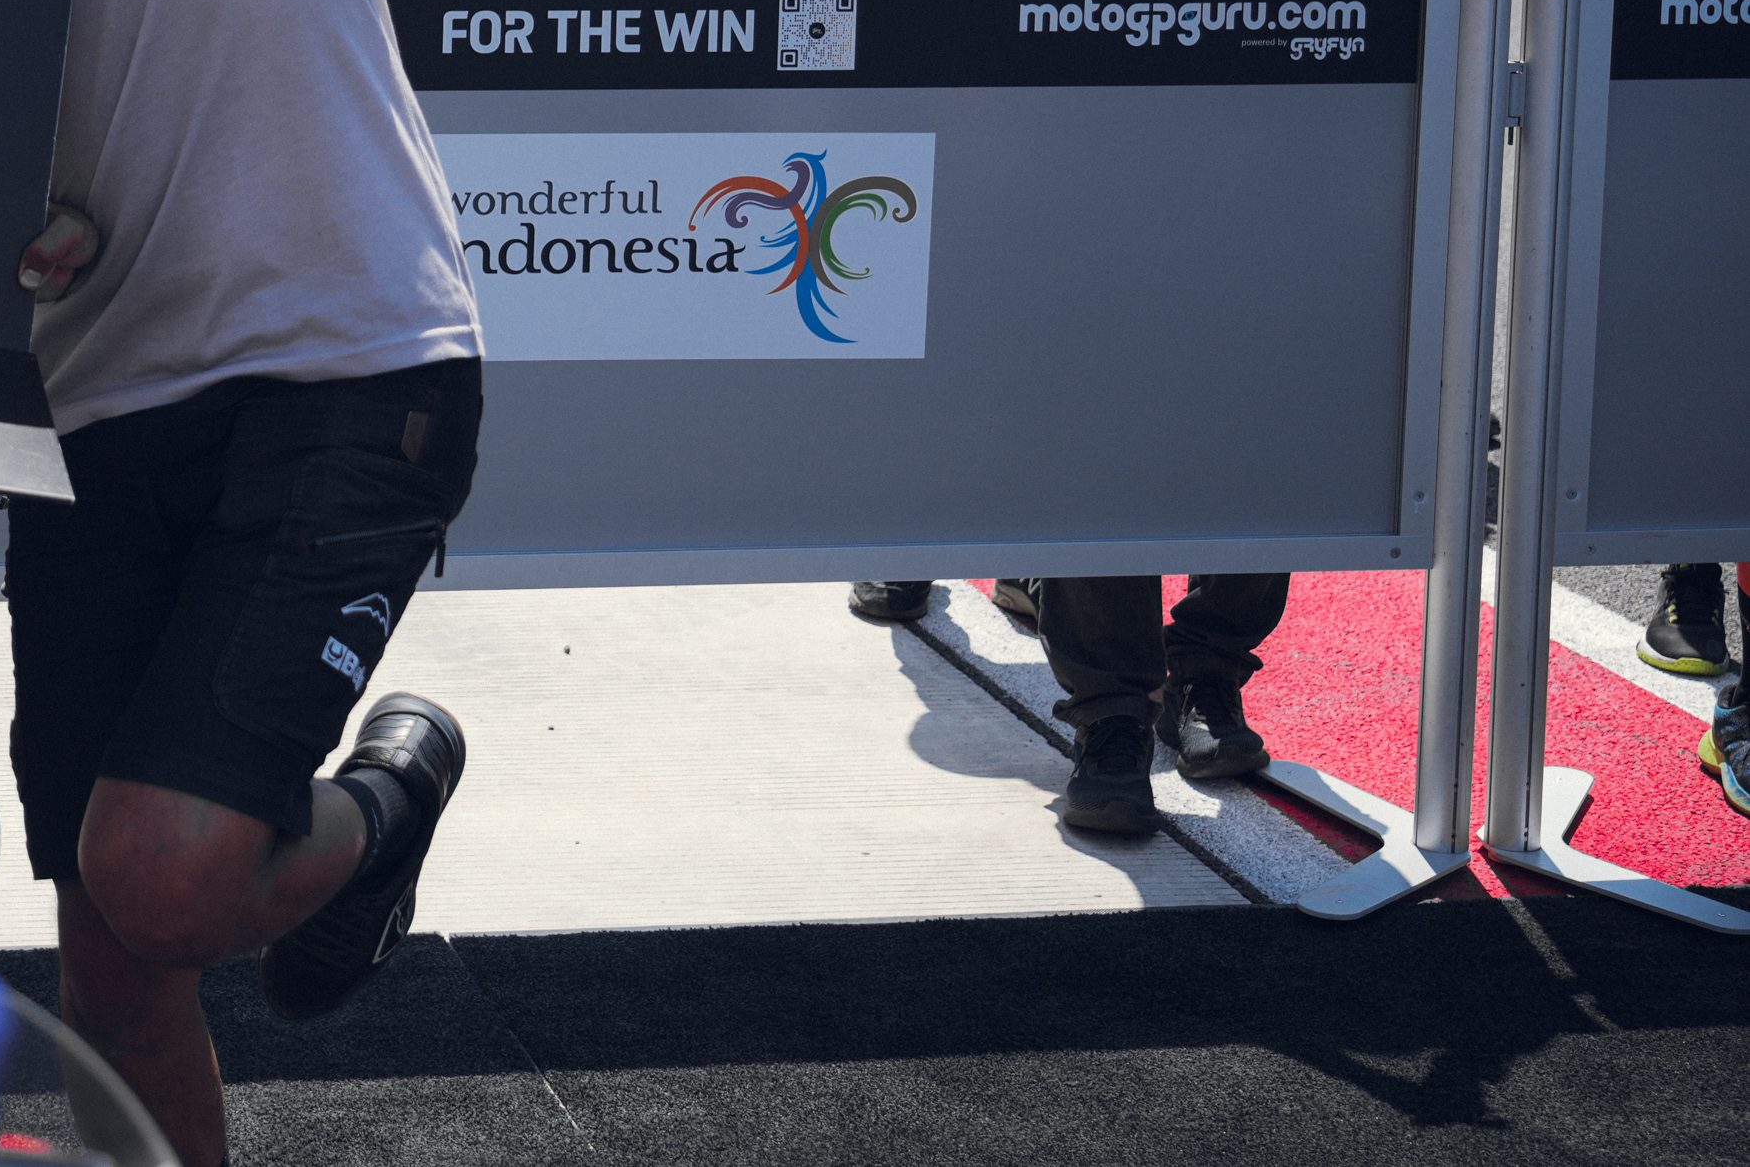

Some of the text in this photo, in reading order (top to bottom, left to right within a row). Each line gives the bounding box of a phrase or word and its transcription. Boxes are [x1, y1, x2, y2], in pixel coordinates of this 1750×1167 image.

[442, 9, 755, 54] FOR THE WIN
[1241, 37, 1288, 49] powered by
[461, 222, 746, 274] ndonesia
